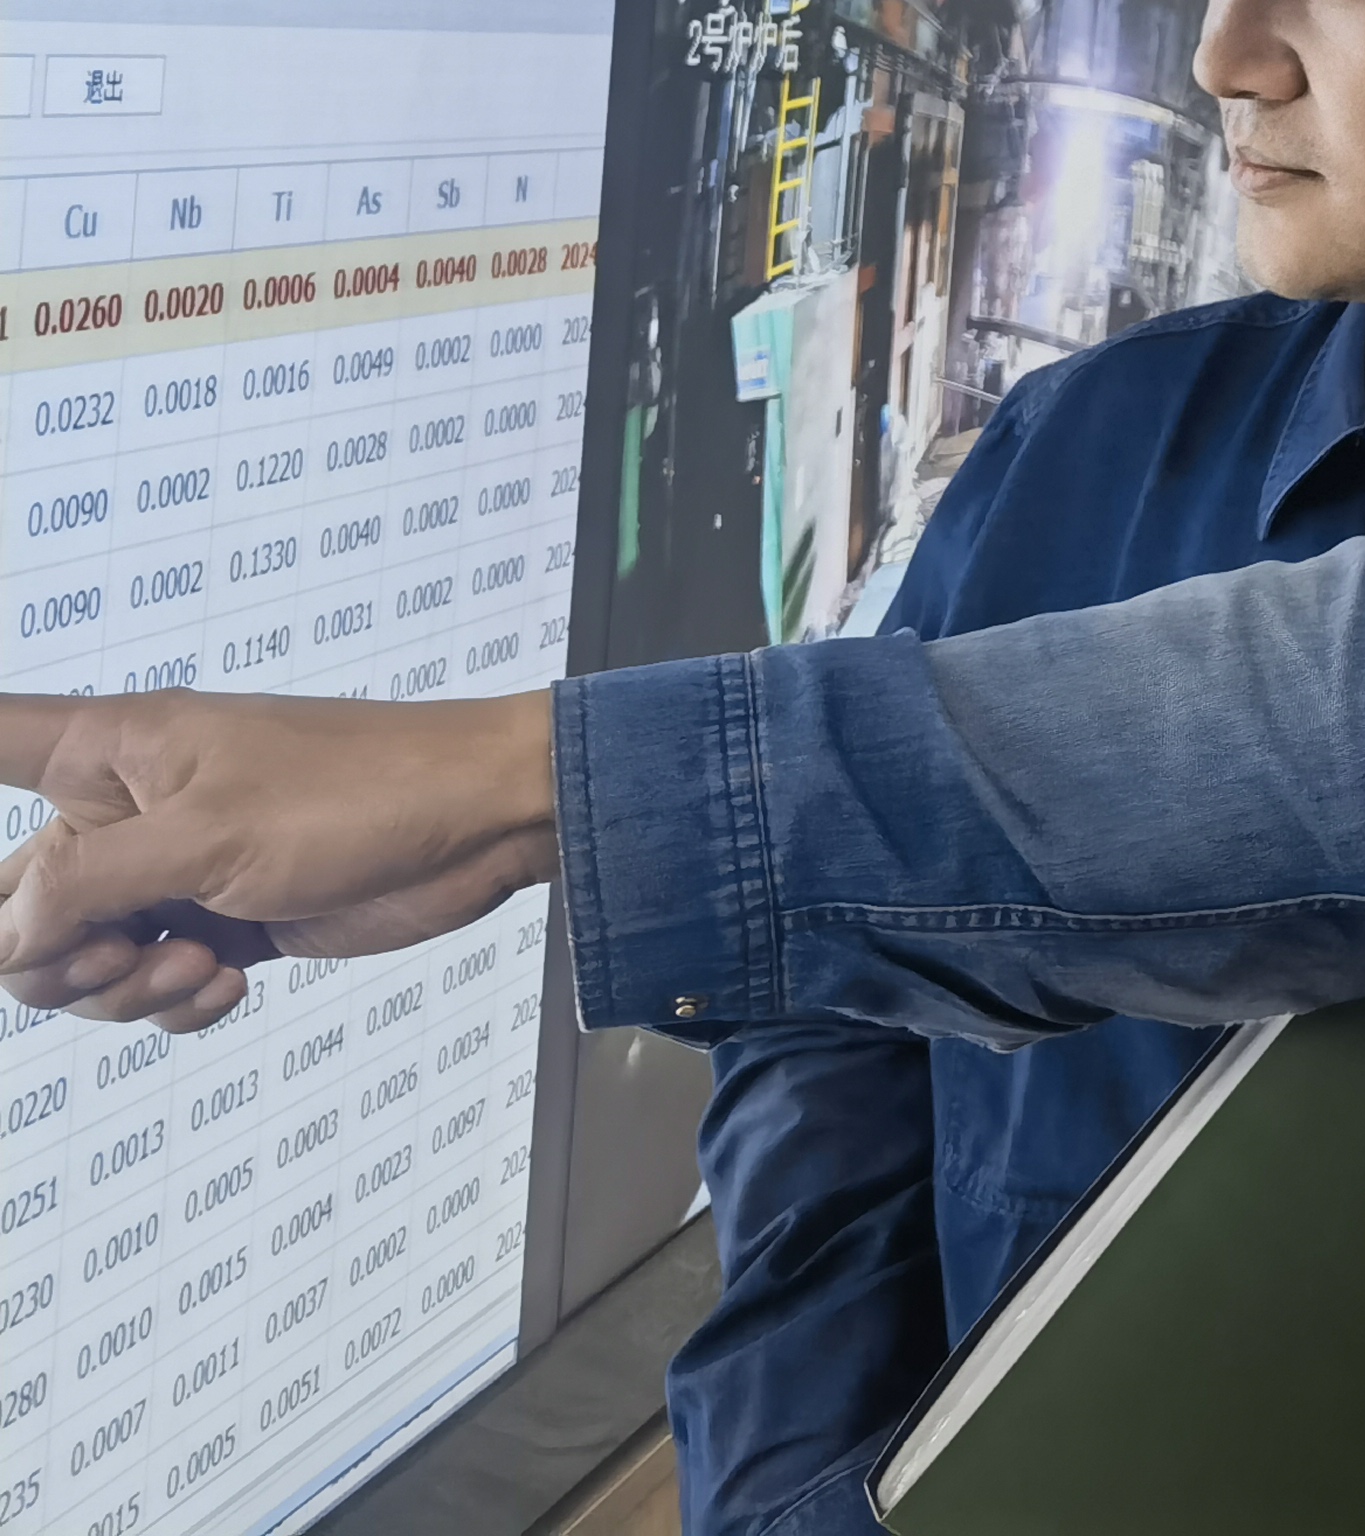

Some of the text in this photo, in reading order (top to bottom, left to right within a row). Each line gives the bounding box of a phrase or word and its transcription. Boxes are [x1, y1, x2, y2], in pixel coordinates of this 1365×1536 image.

[83, 69, 123, 104] 退出
[64, 175, 528, 239] Cu Nb Ti As Sb N
[34, 293, 123, 336] 0.0260
[144, 282, 224, 322] 0.0020
[243, 272, 316, 310] 0.0006
[334, 263, 400, 299] 0.0004
[416, 254, 477, 288] 0.0040
[491, 247, 548, 279] 0.0028
[35, 391, 115, 436] 0.0232
[144, 374, 217, 417] 0.0018
[243, 360, 309, 401] 0.0016
[333, 347, 393, 385] 0.0049
[415, 334, 471, 371] 0.0002
[490, 323, 542, 357] 0.0000
[27, 488, 108, 537] 0.0090
[137, 467, 210, 513] 0.0002
[236, 448, 303, 491] 0.1220
[327, 431, 387, 471] 0.0028
[409, 415, 465, 453] 0.0002
[484, 400, 536, 437] 0.0000
[20, 587, 101, 638] 0.0090
[130, 560, 203, 609] 0.0002
[229, 537, 296, 582] 0.1330
[320, 515, 381, 558] 0.0040
[403, 496, 459, 536] 0.0002
[478, 477, 530, 515] 0.0000
[223, 625, 290, 674] 0.1140
[314, 601, 373, 645] 0.0031
[396, 576, 452, 619] 0.0002
[472, 555, 524, 595] 0.0000
[390, 657, 446, 701] 0.0002
[466, 632, 518, 674] 0.0000
[90, 1119, 164, 1186] 0.0013
[191, 1069, 258, 1132] 0.0013
[282, 1023, 344, 1081] 0.0044
[366, 981, 423, 1036] 0.0002
[443, 942, 496, 994] 0.0000
[96, 1030, 171, 1090] 0.0020
[84, 1213, 158, 1283] 0.0010
[185, 1157, 254, 1223] 0.0005
[277, 1109, 338, 1169] 0.0003
[360, 1062, 418, 1120] 0.0026
[437, 1021, 490, 1074] 0.0034
[77, 1307, 152, 1379] 0.0010
[178, 1246, 248, 1315] 0.0015
[271, 1193, 332, 1256] 0.0004
[355, 1144, 412, 1203] 0.0023
[432, 1097, 485, 1155] 0.0097
[70, 1398, 146, 1477] 0.0007
[172, 1337, 239, 1407] 0.0011
[265, 1276, 328, 1344] 0.0037
[349, 1226, 406, 1287] 0.0002
[426, 1177, 479, 1234] 0.0000
[167, 1423, 236, 1499] 0.0005
[260, 1365, 320, 1432] 0.0051
[345, 1307, 401, 1370] 0.0072
[422, 1255, 475, 1314] 0.0000
